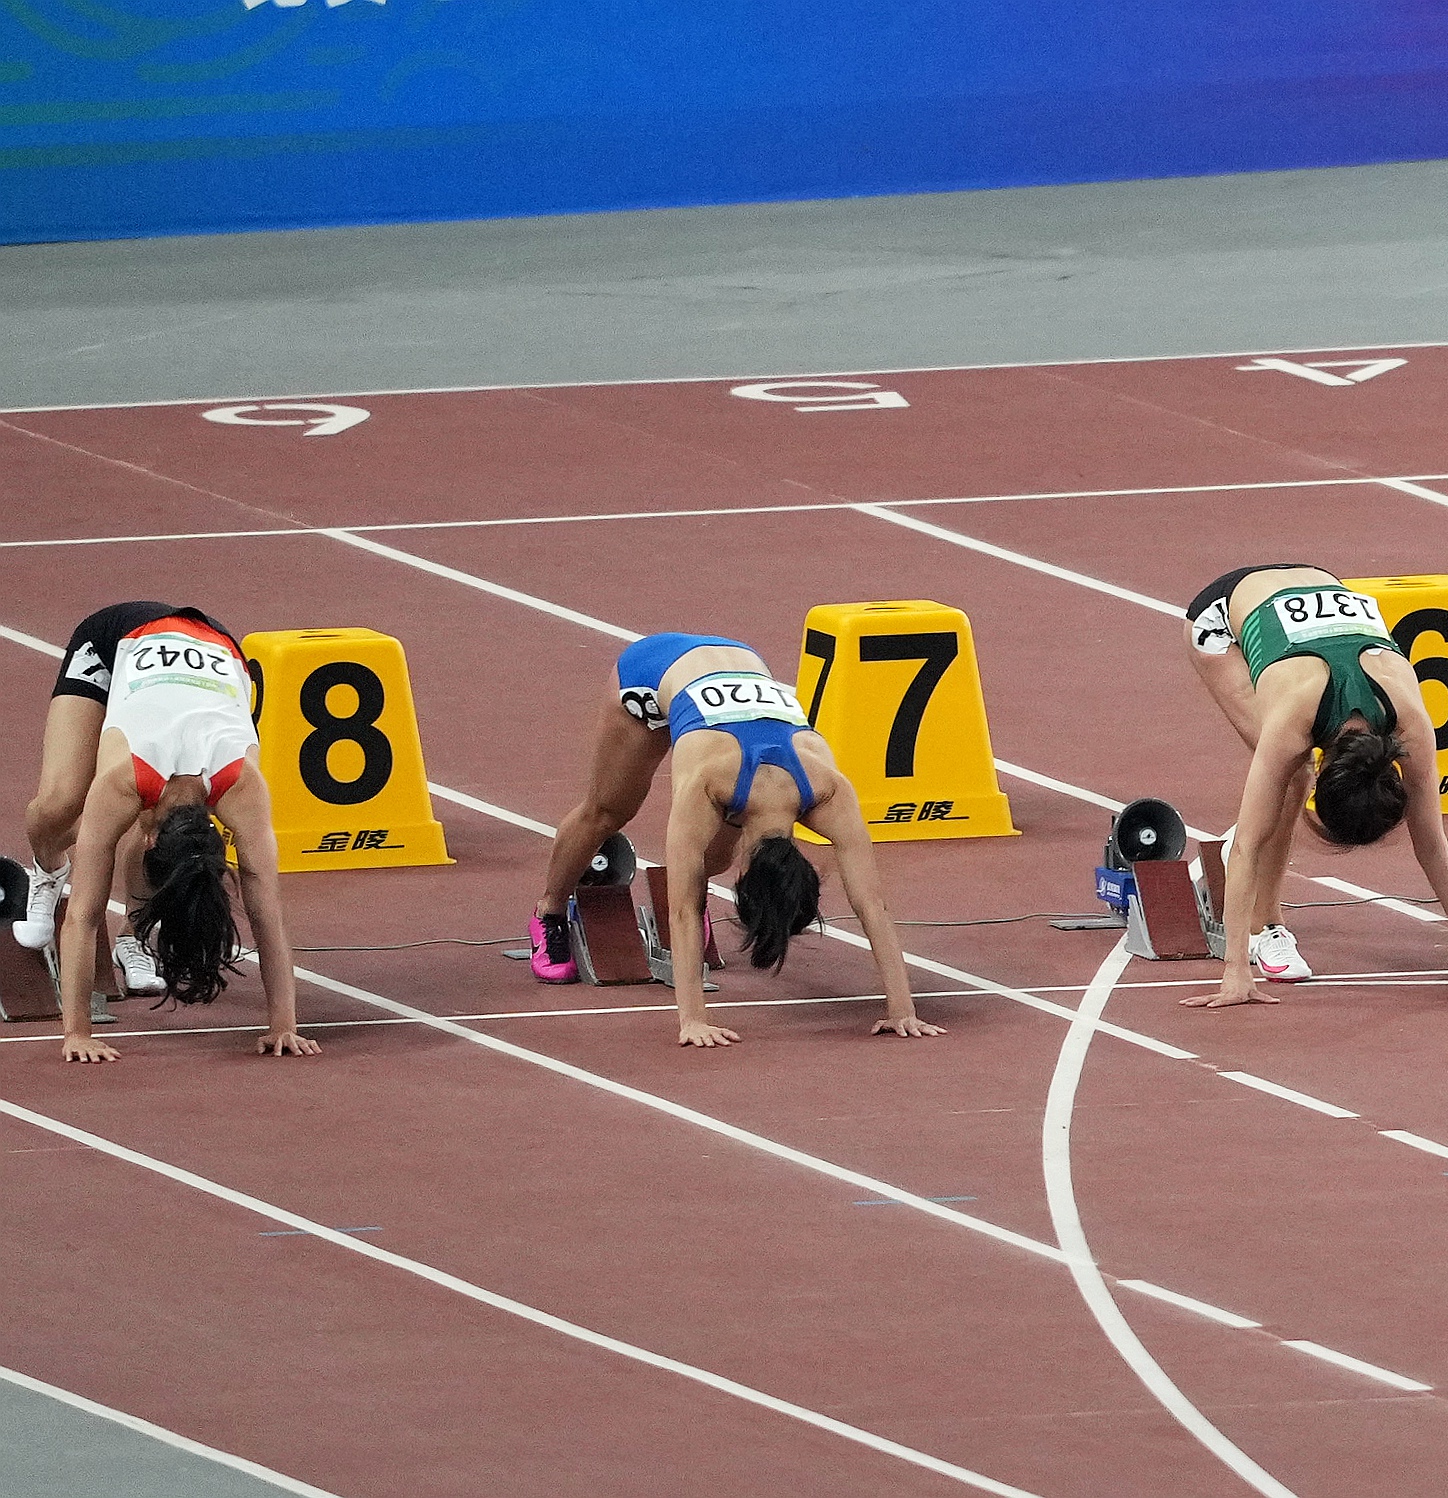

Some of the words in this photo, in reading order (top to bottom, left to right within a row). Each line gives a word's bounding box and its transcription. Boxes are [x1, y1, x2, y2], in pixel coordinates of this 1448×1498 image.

[731, 381, 910, 412] 5
[1288, 596, 1377, 623] 1378
[133, 644, 230, 676] 2042
[805, 628, 836, 730] 7
[700, 681, 796, 709] 1720
[859, 632, 958, 778] 7
[299, 661, 393, 805] 8
[868, 801, 969, 824] 金陵
[302, 829, 405, 853] 金陵
